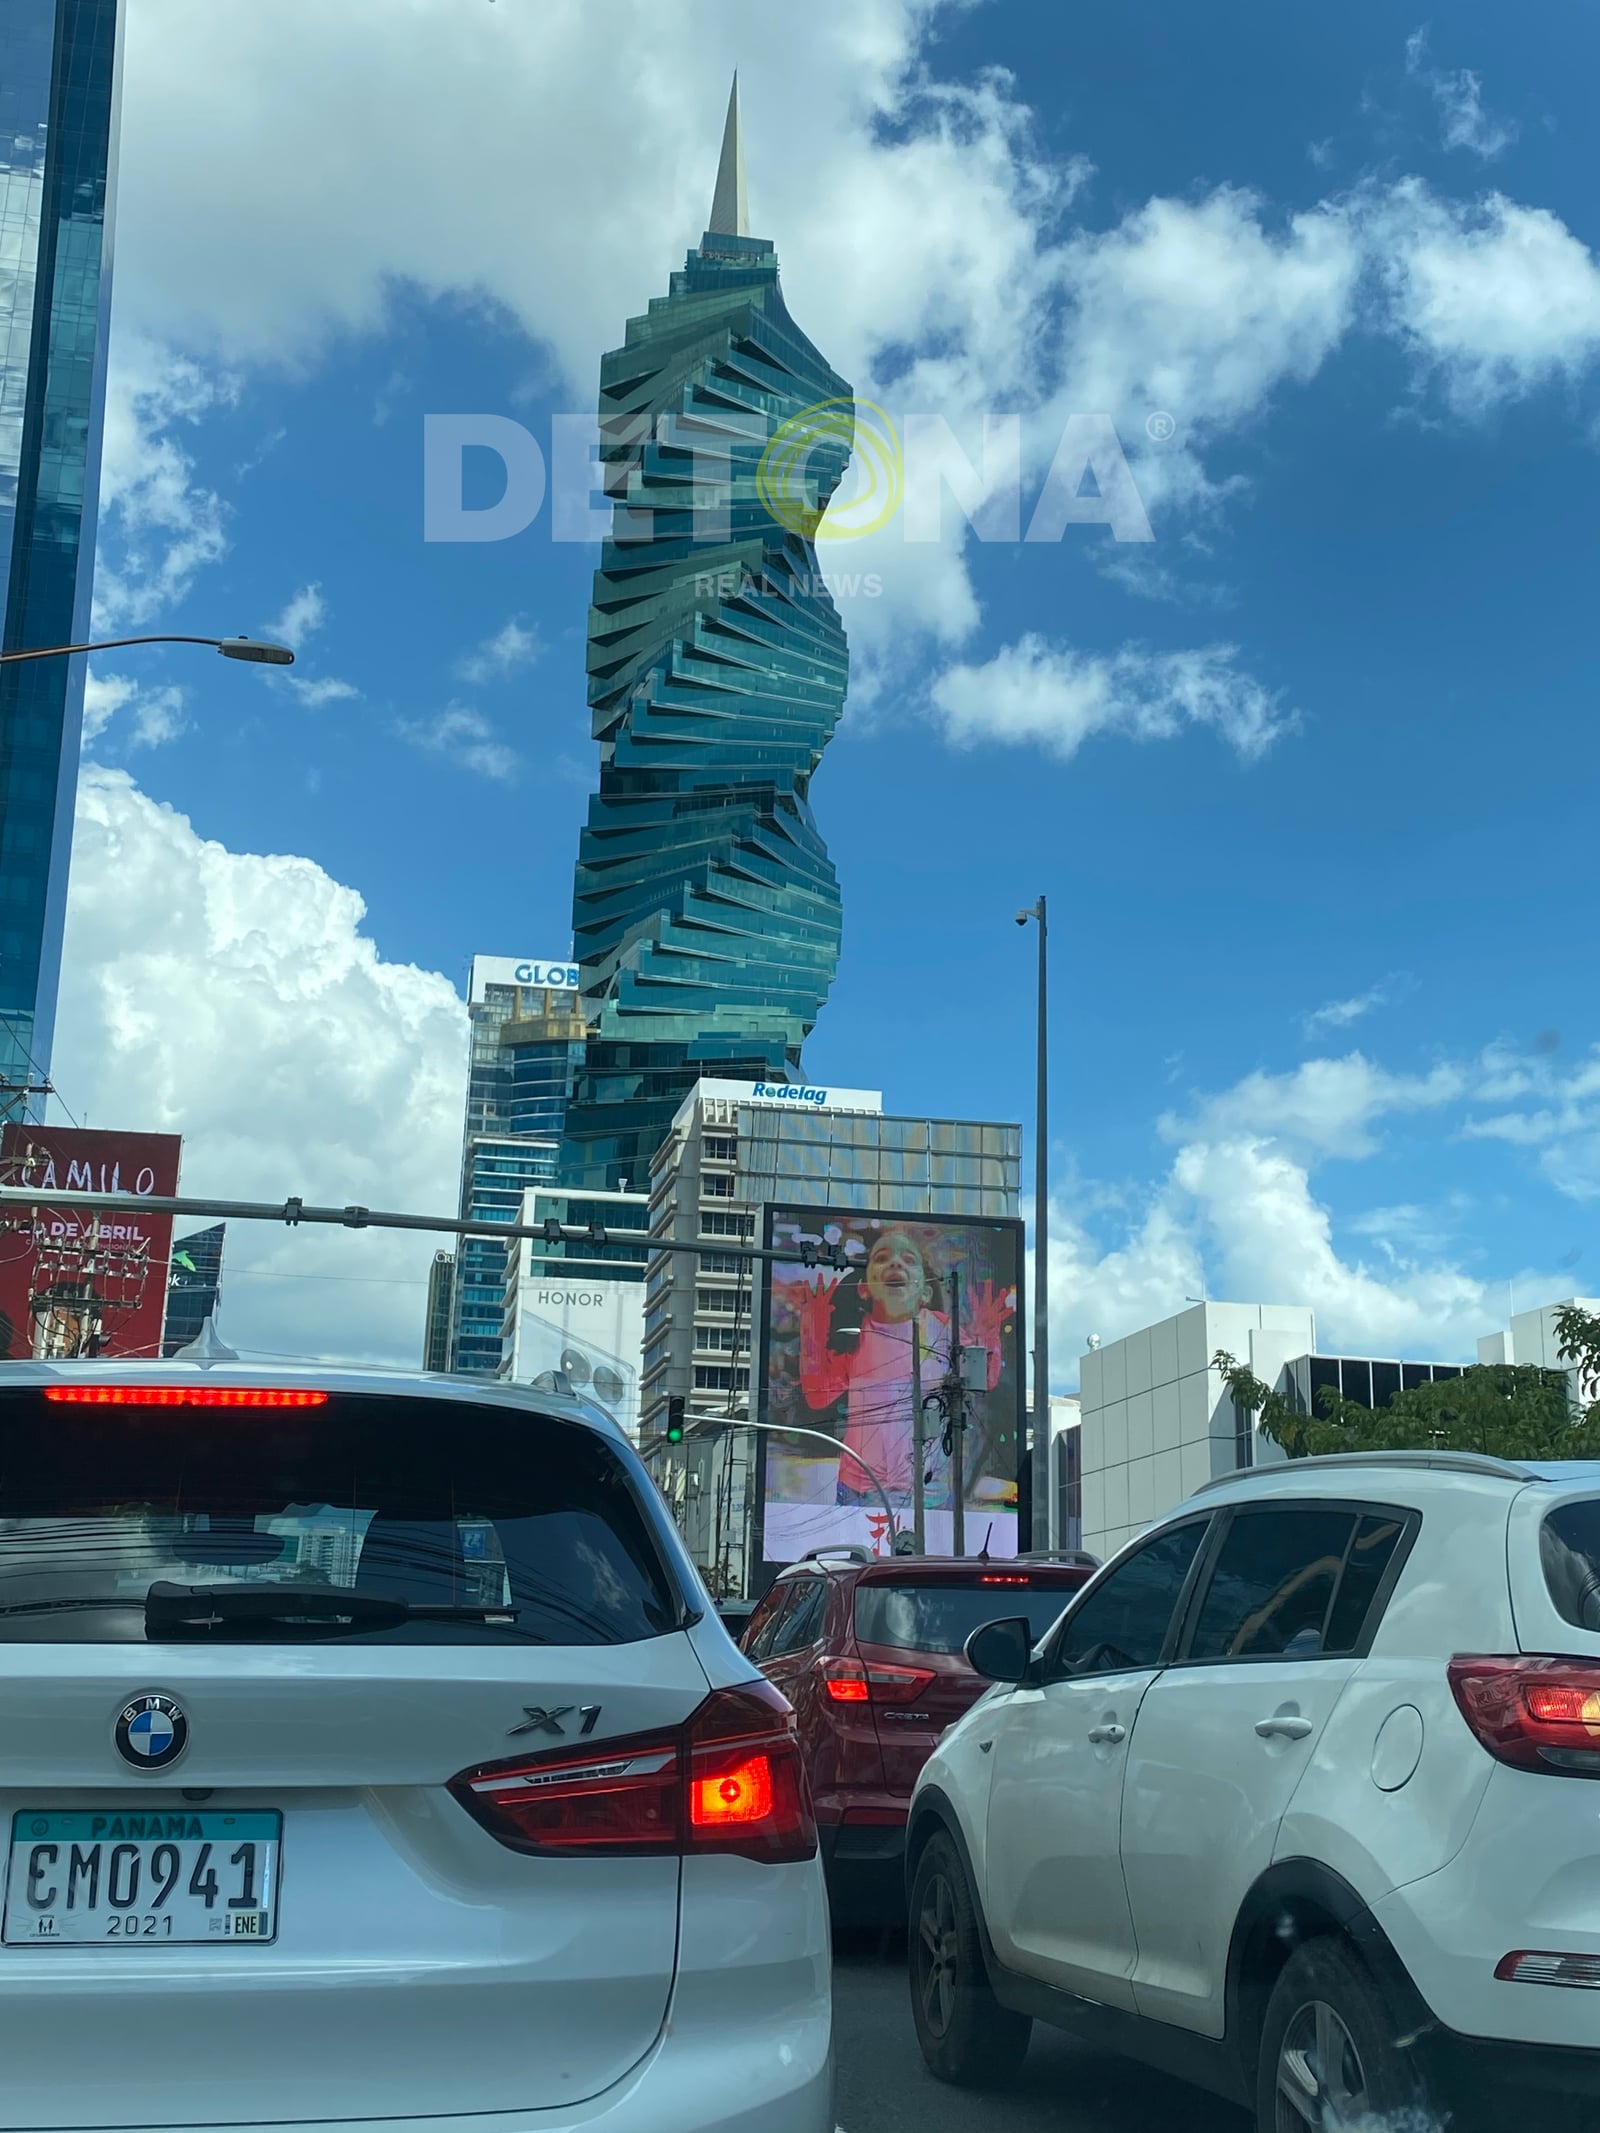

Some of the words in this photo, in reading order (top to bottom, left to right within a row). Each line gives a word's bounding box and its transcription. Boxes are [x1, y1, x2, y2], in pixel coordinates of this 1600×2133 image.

[515, 964, 579, 987] GLOB
[752, 1083, 828, 1105] Rodelag
[51, 1222, 79, 1237] DE
[538, 1291, 603, 1307] HONOR
[123, 1698, 183, 1722] BMW
[506, 1705, 602, 1735] X1
[91, 1816, 204, 1839] PANAMA
[106, 1915, 173, 1936] 2021
[235, 1916, 257, 1934] ENE
